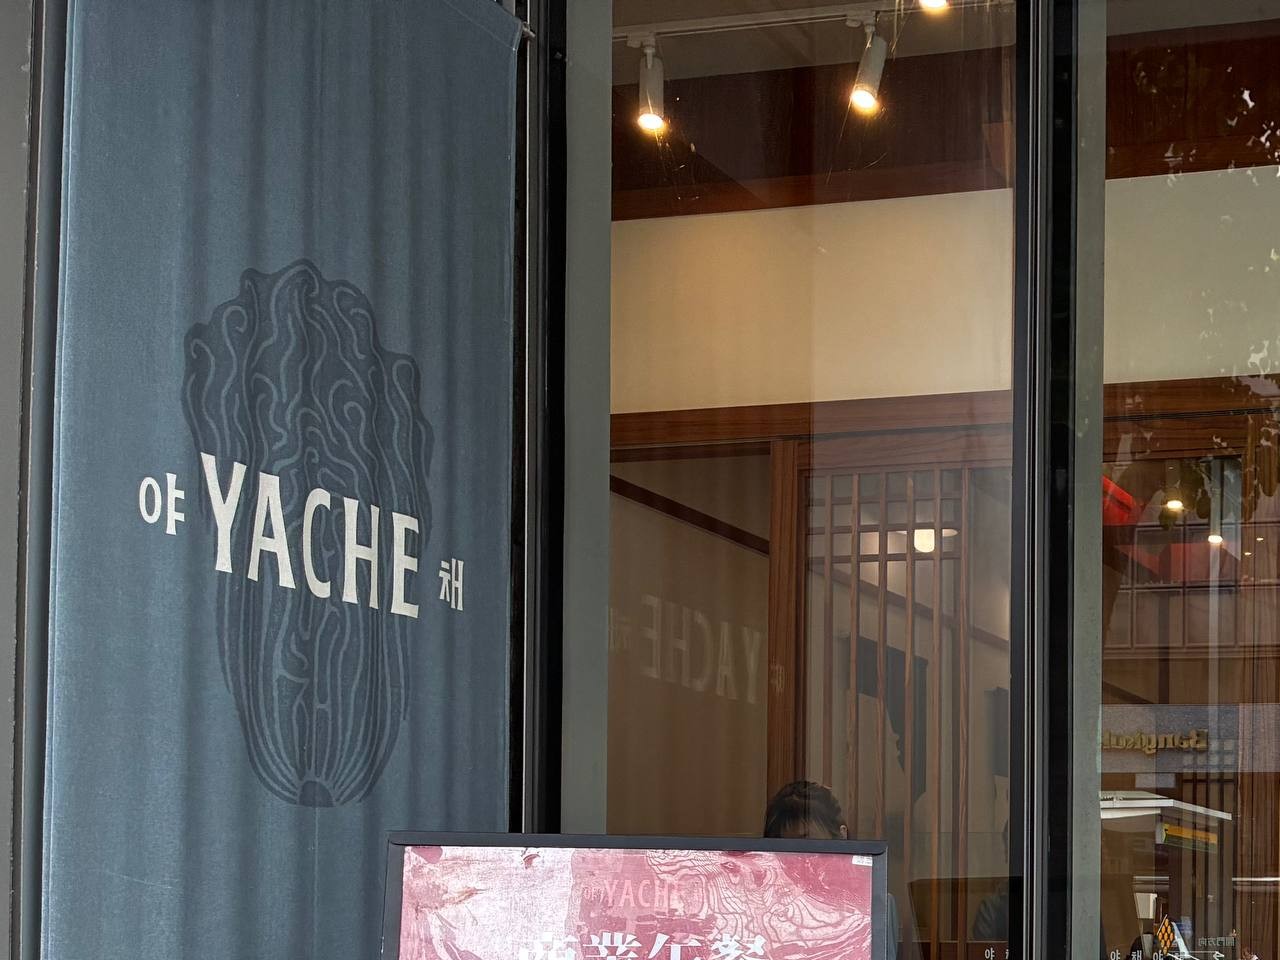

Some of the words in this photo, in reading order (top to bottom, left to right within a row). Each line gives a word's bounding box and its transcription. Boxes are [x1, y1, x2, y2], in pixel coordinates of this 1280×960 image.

[138, 472, 185, 536] 야
[200, 452, 421, 619] YACHE
[438, 557, 465, 612] 채
